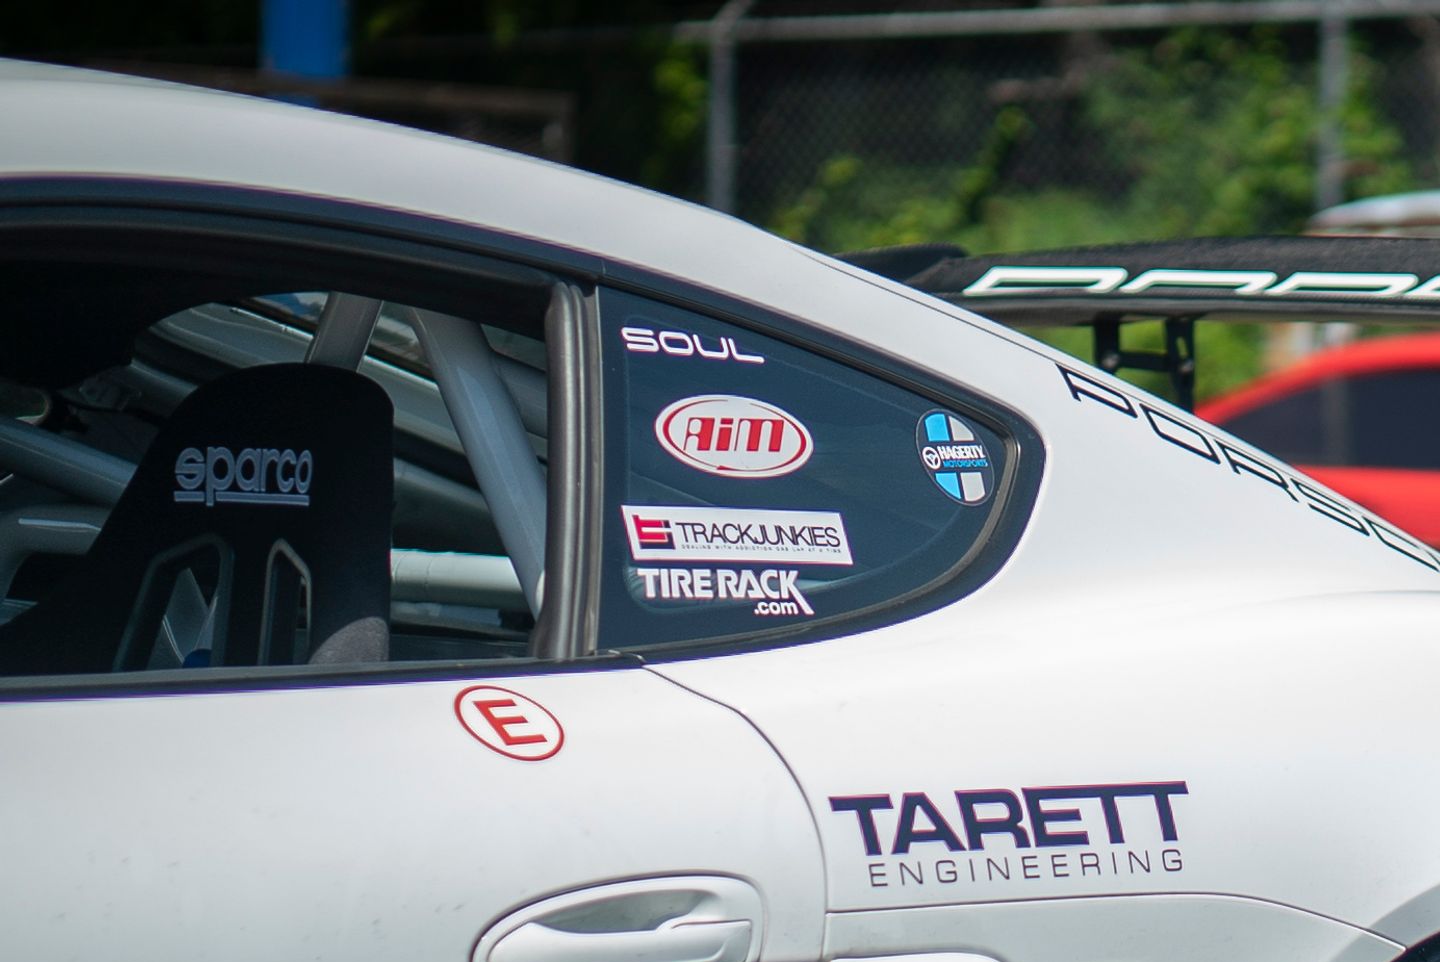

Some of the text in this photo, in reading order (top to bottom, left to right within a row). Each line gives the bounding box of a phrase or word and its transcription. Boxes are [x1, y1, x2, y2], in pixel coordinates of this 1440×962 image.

[621, 326, 765, 364] SOUL
[936, 445, 986, 460] HAGERTY
[174, 446, 313, 506] sparco
[675, 521, 841, 548] TRACKJUNKIES
[637, 568, 815, 615] TIRE RACK
[754, 601, 799, 615] .com
[471, 698, 548, 746] E
[828, 780, 1190, 856] TARETT
[868, 848, 1183, 887] ENGINEERING
